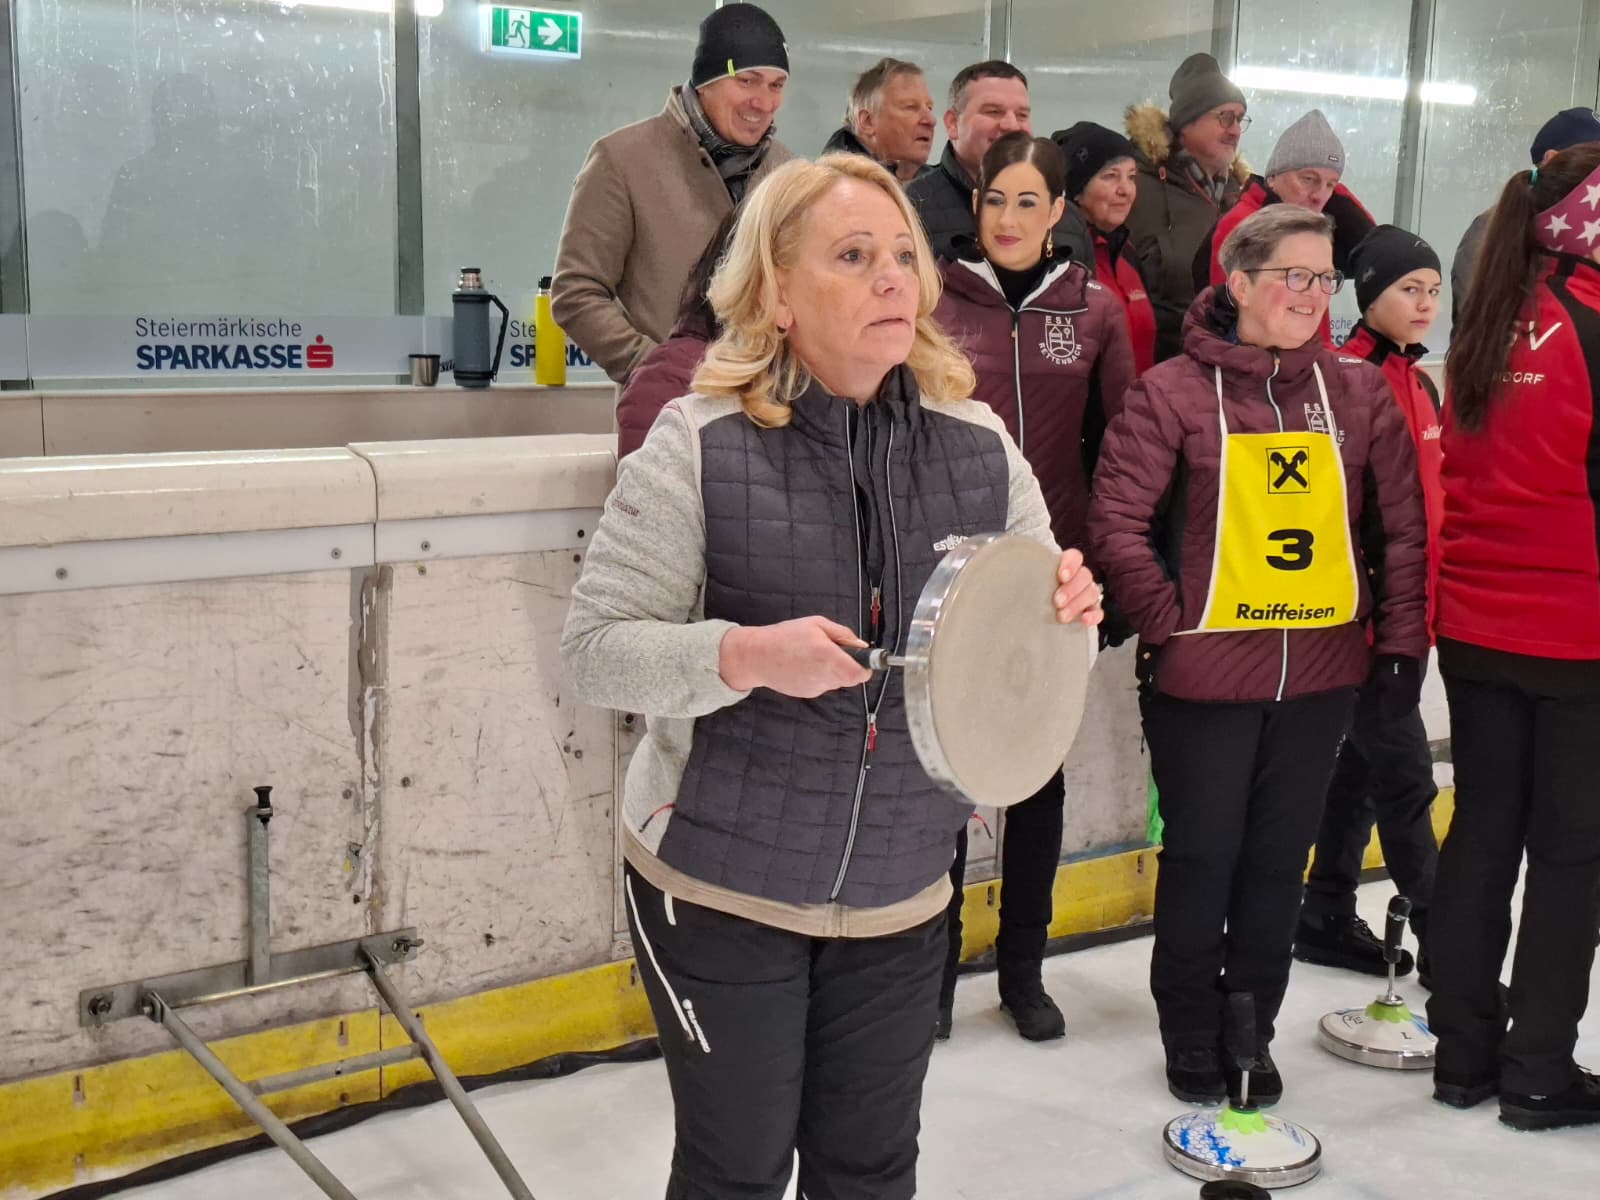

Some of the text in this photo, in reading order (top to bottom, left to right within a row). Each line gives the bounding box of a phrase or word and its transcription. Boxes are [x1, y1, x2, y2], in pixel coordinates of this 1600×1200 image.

[135, 317, 303, 338] Steiermärkische
[136, 344, 302, 370] SPARKASSE
[1265, 528, 1315, 571] 3
[1236, 603, 1336, 621] Raiffeisen
